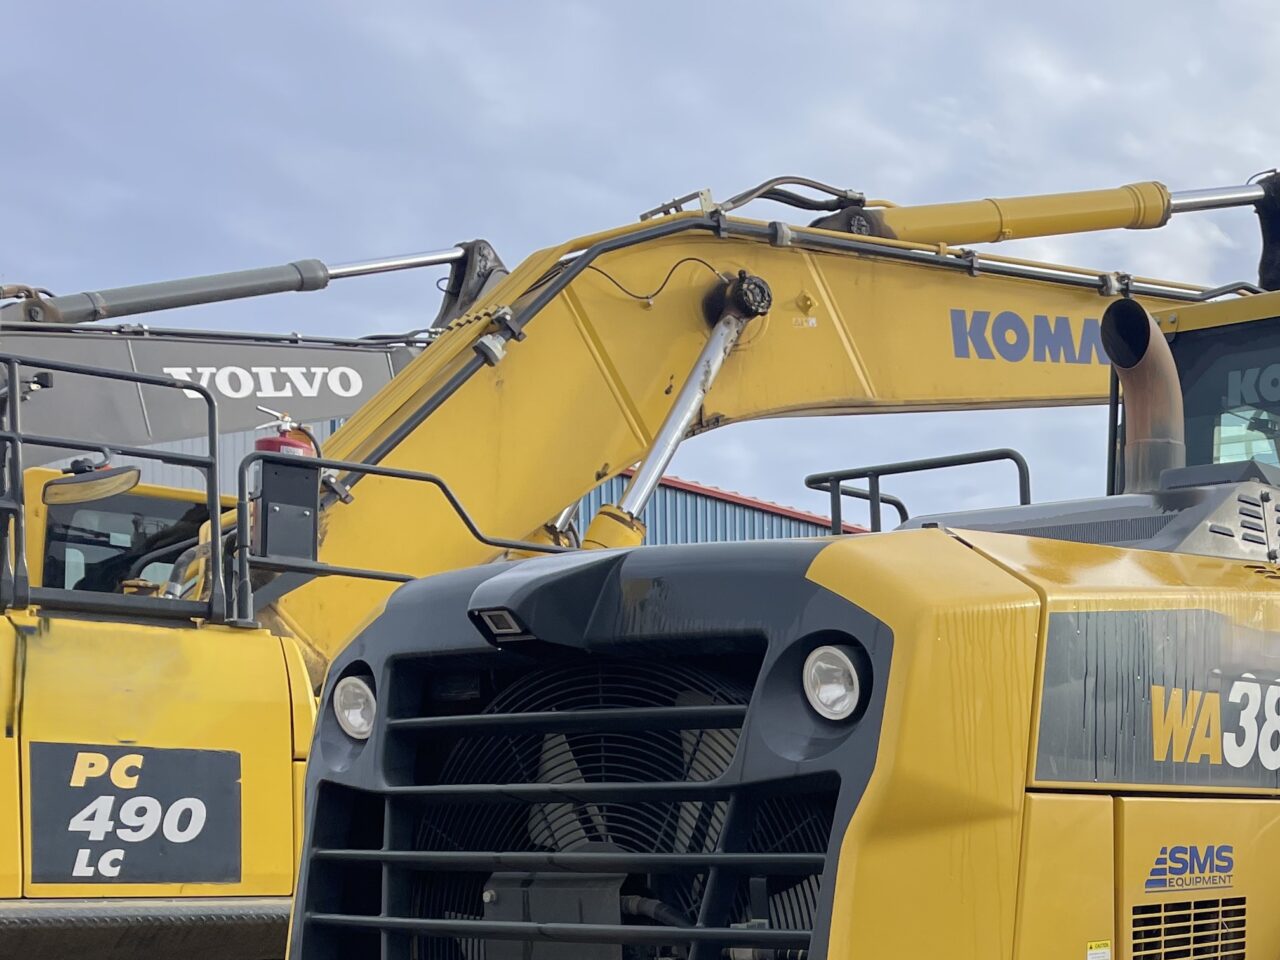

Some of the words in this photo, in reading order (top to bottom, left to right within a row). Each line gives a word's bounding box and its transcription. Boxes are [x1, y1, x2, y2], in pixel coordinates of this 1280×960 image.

[162, 366, 363, 399] VOLVO
[70, 752, 144, 789] PC
[68, 795, 207, 843] 490
[72, 849, 125, 877] LC
[1168, 845, 1234, 875] SMS
[1168, 875, 1233, 888] EQUIPMENT
